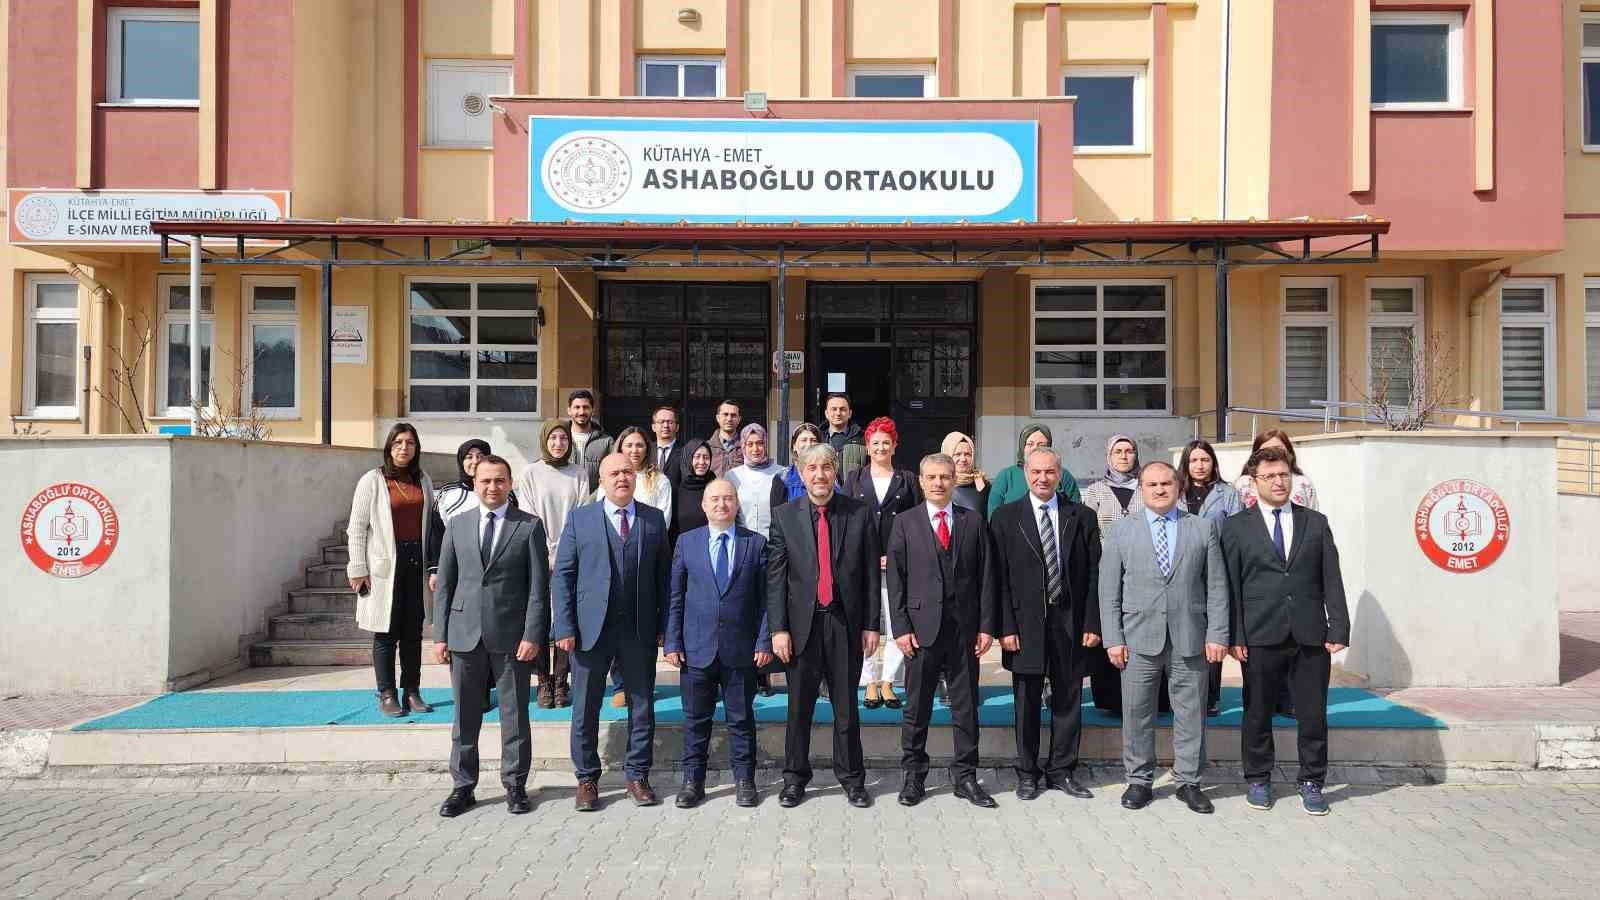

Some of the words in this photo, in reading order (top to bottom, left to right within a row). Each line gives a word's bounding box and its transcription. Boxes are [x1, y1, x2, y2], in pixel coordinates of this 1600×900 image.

[643, 144, 711, 162] KÜTAHYA
[723, 148, 762, 162] EMET
[642, 164, 814, 191] ASHABOĞLU
[824, 169, 994, 191] ORTAOKULU
[68, 208, 94, 222] İLÇE
[98, 208, 131, 220] MİLLİ
[134, 208, 178, 220] EĞİTİM
[68, 224, 117, 235] E-SINAV
[121, 224, 154, 235] MER
[71, 486, 116, 536] ORTAOKULU
[57, 547, 81, 556] 2012
[1452, 542, 1475, 552] 2012
[1447, 556, 1478, 569] EMET
